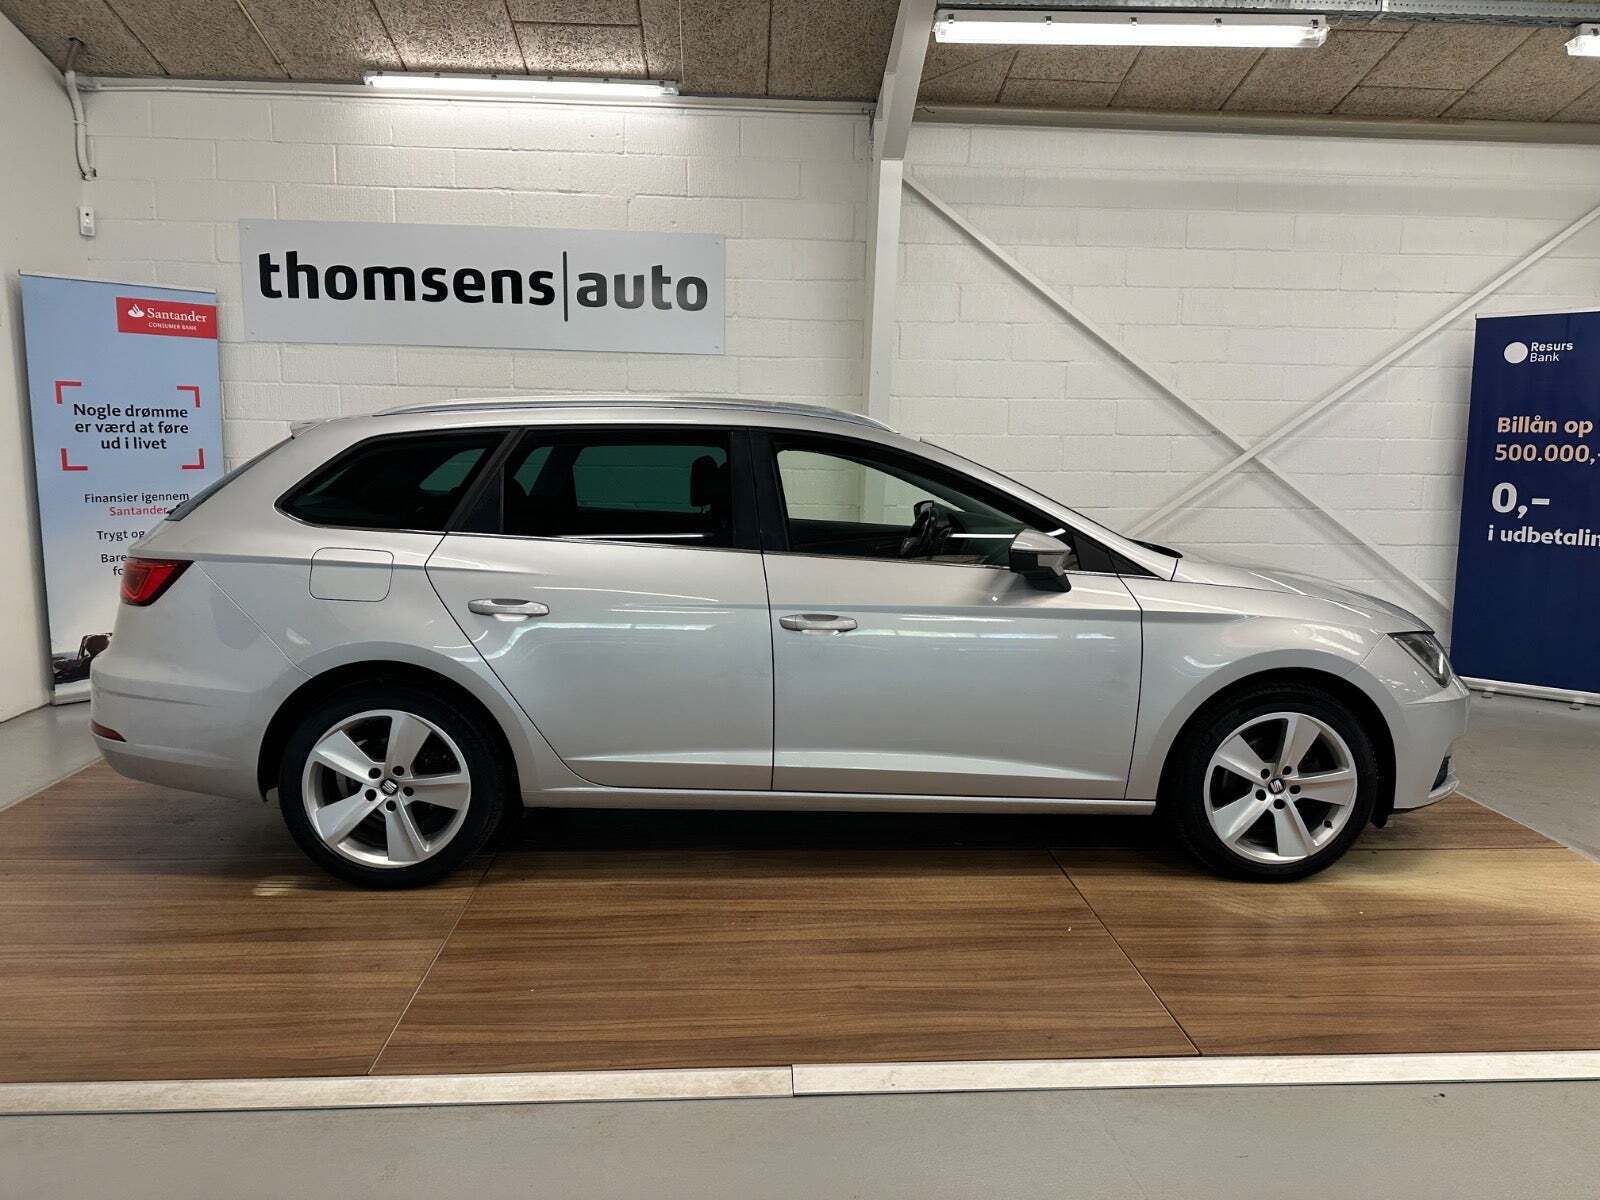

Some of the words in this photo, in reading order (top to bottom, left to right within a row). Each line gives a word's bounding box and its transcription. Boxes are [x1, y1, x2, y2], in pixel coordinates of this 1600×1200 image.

[258, 250, 555, 306] thomsens
[576, 264, 708, 312] auto
[147, 307, 207, 322] Santander
[1530, 342, 1574, 351] Resurs
[1530, 352, 1560, 362] Bank
[73, 403, 121, 420] Nogle
[125, 404, 188, 418] drømme
[75, 423, 91, 433] er
[96, 421, 136, 433] værd
[139, 423, 154, 433] at
[158, 421, 189, 434] føre
[1497, 415, 1557, 433] Billån
[1564, 420, 1593, 437] op
[101, 437, 120, 449] ud
[125, 437, 129, 448] i
[134, 437, 167, 449] livet
[1495, 444, 1600, 465] 500.000,
[84, 493, 137, 503] Finansier
[141, 492, 189, 503] igennem
[110, 506, 167, 516] Santander
[96, 530, 128, 542] Trygt
[1488, 525, 1494, 541] i
[101, 553, 127, 563] Bare
